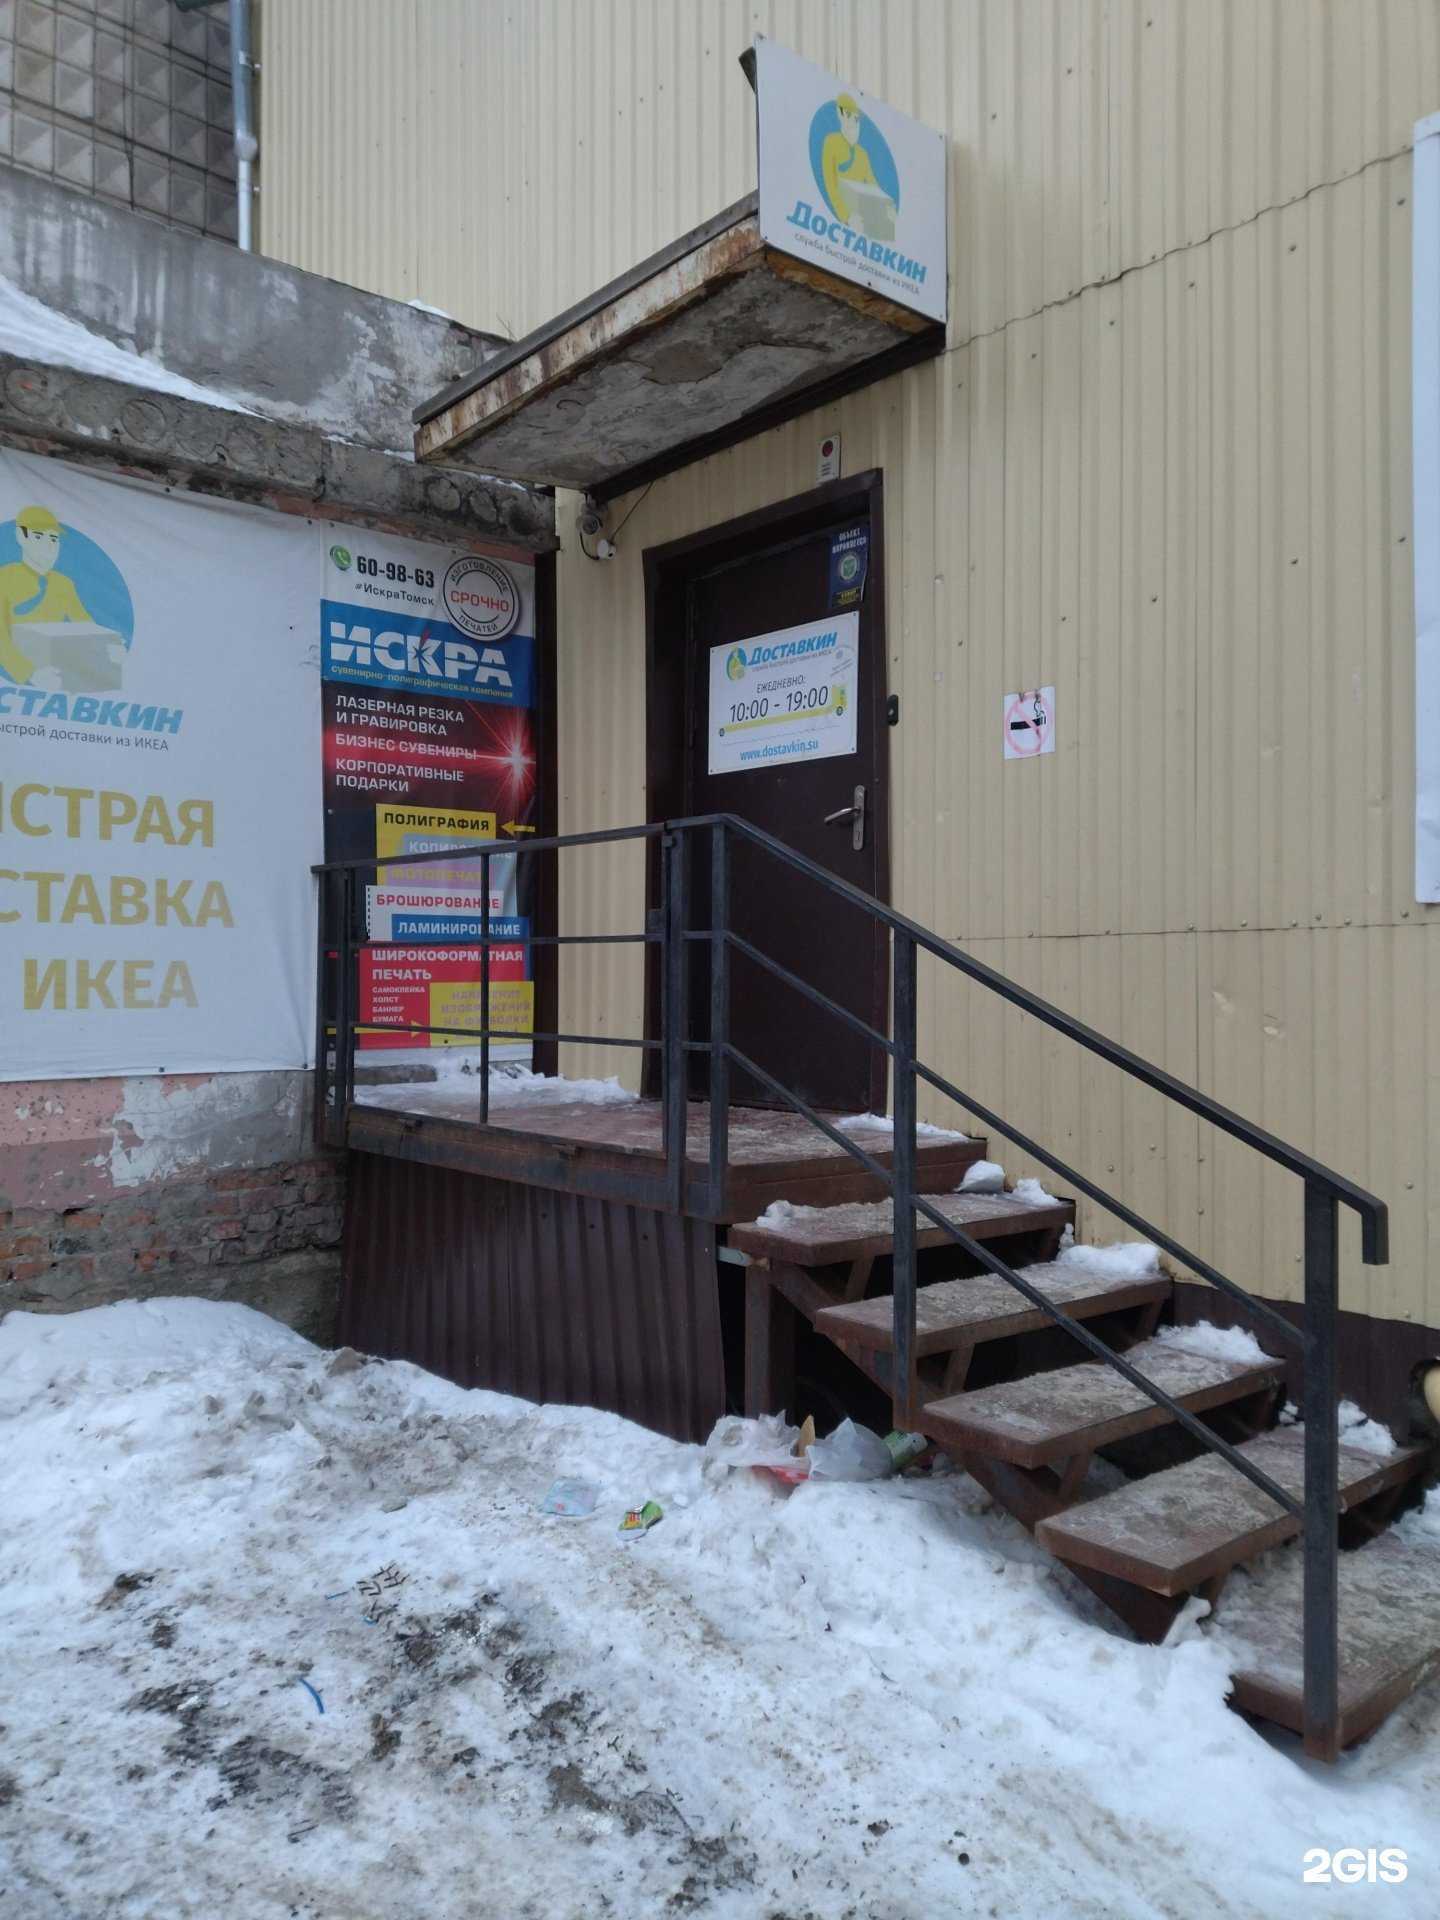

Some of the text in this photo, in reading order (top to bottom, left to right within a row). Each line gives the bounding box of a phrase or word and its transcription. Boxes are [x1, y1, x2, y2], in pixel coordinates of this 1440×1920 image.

[357, 555, 435, 588] 60-98-63
[355, 583, 435, 606] #ИскраТомск
[450, 590, 509, 612] СРОЧНО
[459, 615, 498, 633] ПЕЧАТЕЙ
[330, 621, 513, 687] ИСКРА
[757, 674, 806, 694] ЕЖЕДНЕВНО:
[336, 695, 465, 723] ЛАЗЕРНАЯ РЕЗКА
[730, 698, 769, 723] 10:00
[786, 686, 829, 712] 19:00
[336, 711, 447, 736] И ГРАВИРОВКА
[49, 728, 112, 746] доставки
[115, 736, 131, 748] из
[135, 737, 169, 751] ИКЕА
[336, 734, 477, 760] БИЗНЕС СУВЕНИРЫ
[740, 738, 818, 761] www.dostavkin.su
[336, 758, 465, 782] КОРПОРАТИВНЫЕ
[336, 774, 409, 792] ПОДАРКИ
[0, 781, 214, 848] СТРАЯ
[384, 812, 489, 831] ПОЛИГРАФИЯ
[377, 894, 499, 909] БРОШЮРОВАНЕ
[398, 921, 521, 936] ЛАМИНИРОАНИЕ
[23, 958, 199, 1010] ИКЕА
[372, 969, 432, 981] ПЕЧАТЬ
[372, 996, 400, 1004] ХОЛСТ
[372, 1006, 405, 1014] БАННЕР
[372, 1015, 404, 1024] БУМАГА
